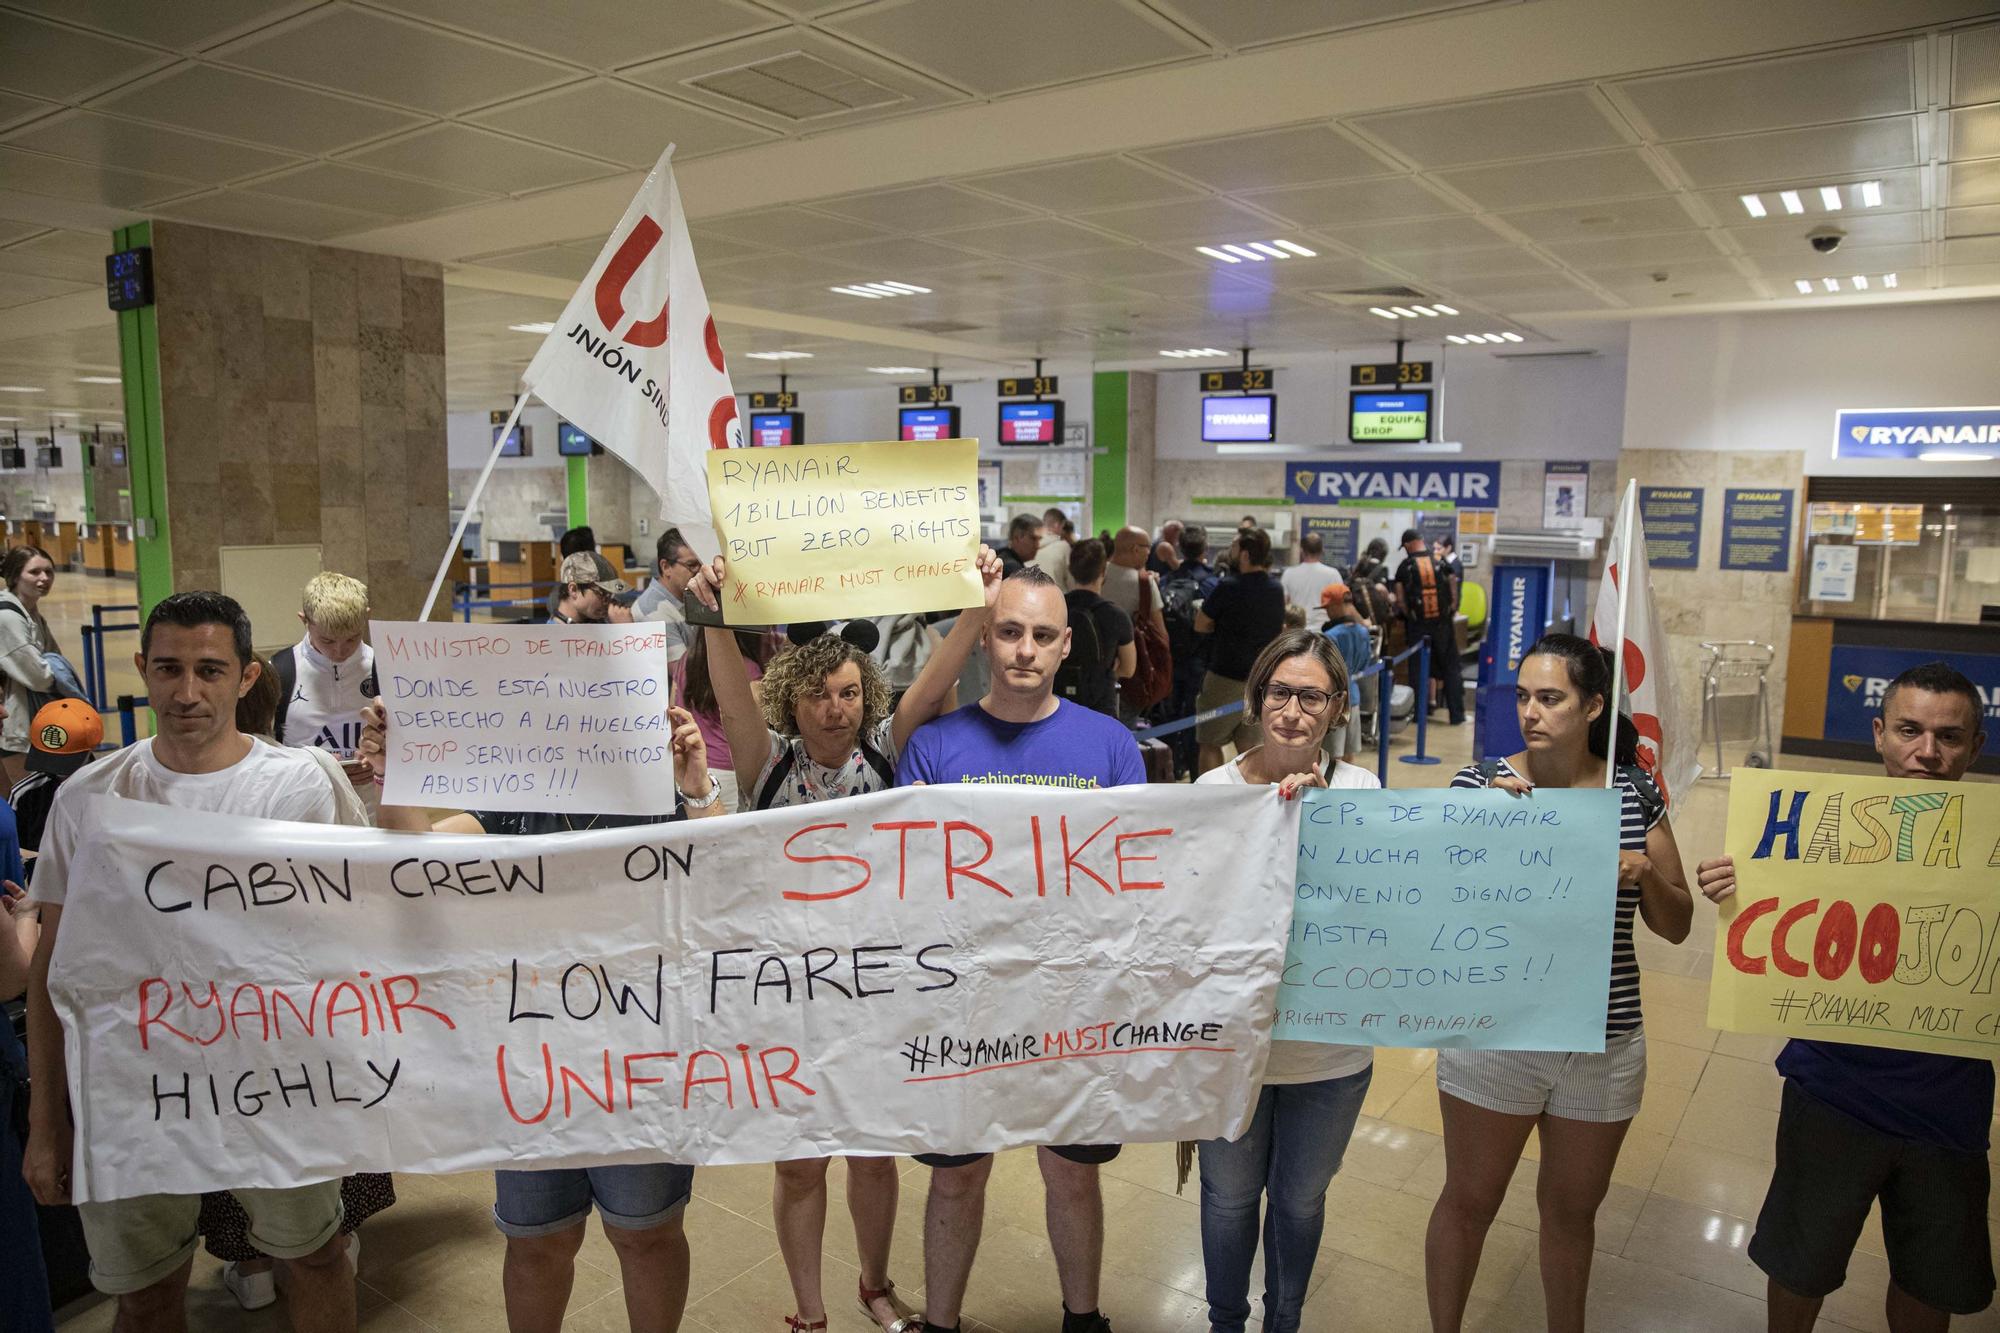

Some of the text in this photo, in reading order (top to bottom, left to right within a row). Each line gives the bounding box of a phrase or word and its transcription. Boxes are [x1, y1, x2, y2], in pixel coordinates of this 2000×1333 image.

[1242, 371, 1265, 389] 32
[1398, 364, 1424, 382] 33
[929, 384, 947, 401] 30
[1033, 377, 1052, 395] 31
[777, 393, 793, 408] 29
[1380, 414, 1425, 425] EQUIPA
[1363, 426, 1394, 437] DROP
[1318, 472, 1490, 499] RYANAIR
[730, 537, 776, 562] BUT
[801, 527, 870, 552] ZERO
[840, 569, 884, 587] MUST
[894, 558, 968, 582] CHANGE
[1507, 576, 1526, 660] RYANAIR
[524, 639, 552, 656] DE
[560, 633, 666, 658] TRANSPORTE
[393, 672, 657, 699] DONDE ESTÁ NUESTRO
[395, 710, 504, 729] DERECHO
[519, 711, 532, 728] A
[546, 714, 569, 732] LA
[401, 741, 458, 763] STOP
[961, 771, 1097, 789] #cabincrewunited
[1389, 804, 1424, 822] DE
[1751, 789, 1965, 868] HASTA
[391, 856, 544, 899] CREW
[623, 844, 693, 882] ON
[782, 815, 1175, 901] STRIKE
[1336, 847, 1420, 865] LUCHA
[1445, 846, 1488, 866] POR
[1520, 847, 1553, 867] UN
[1297, 883, 1422, 905] ONVENIO
[1430, 923, 1510, 951] LOS
[508, 955, 662, 1025] LOW
[710, 943, 958, 1015] FARES
[1361, 1013, 1386, 1027] AT
[1908, 1005, 1964, 1033] MUST
[152, 1058, 400, 1121] HIGHLY
